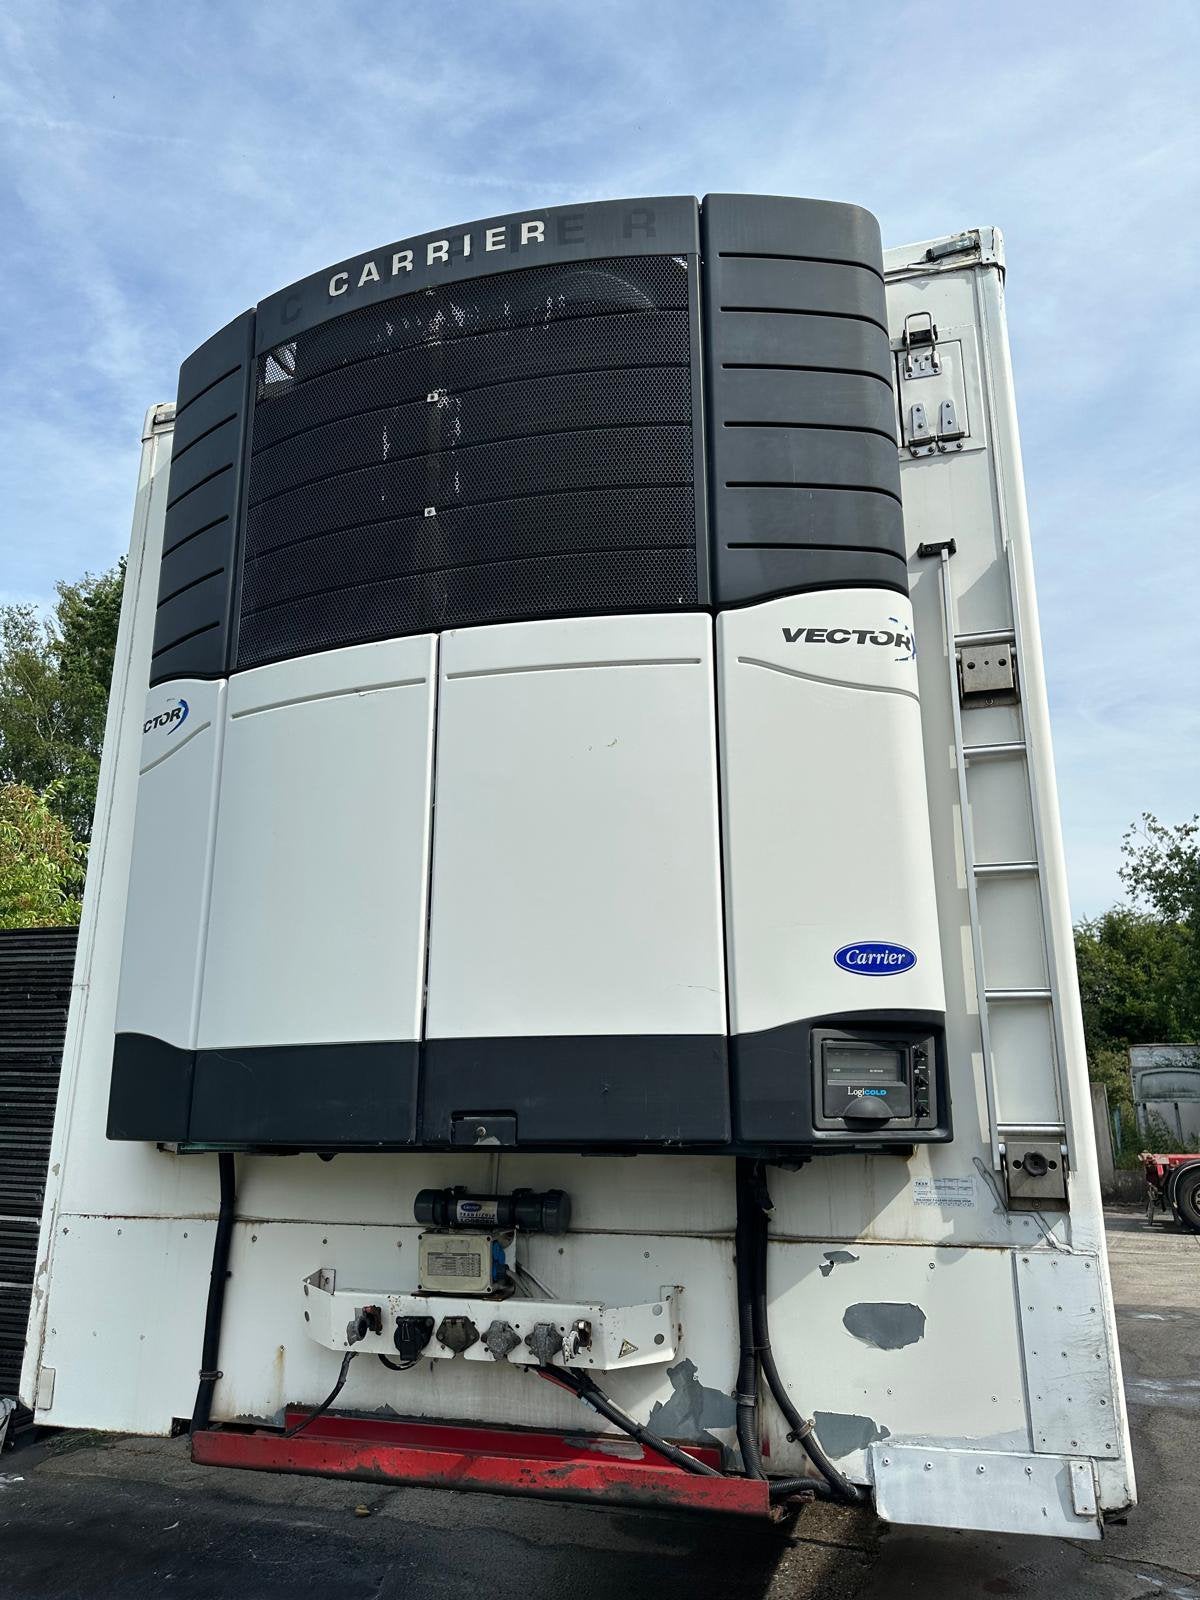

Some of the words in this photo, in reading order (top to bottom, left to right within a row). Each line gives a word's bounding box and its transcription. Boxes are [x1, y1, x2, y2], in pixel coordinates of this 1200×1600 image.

[328, 220, 546, 298] CARRIER
[781, 627, 912, 651] VECTOR
[845, 949, 906, 965] Carrier
